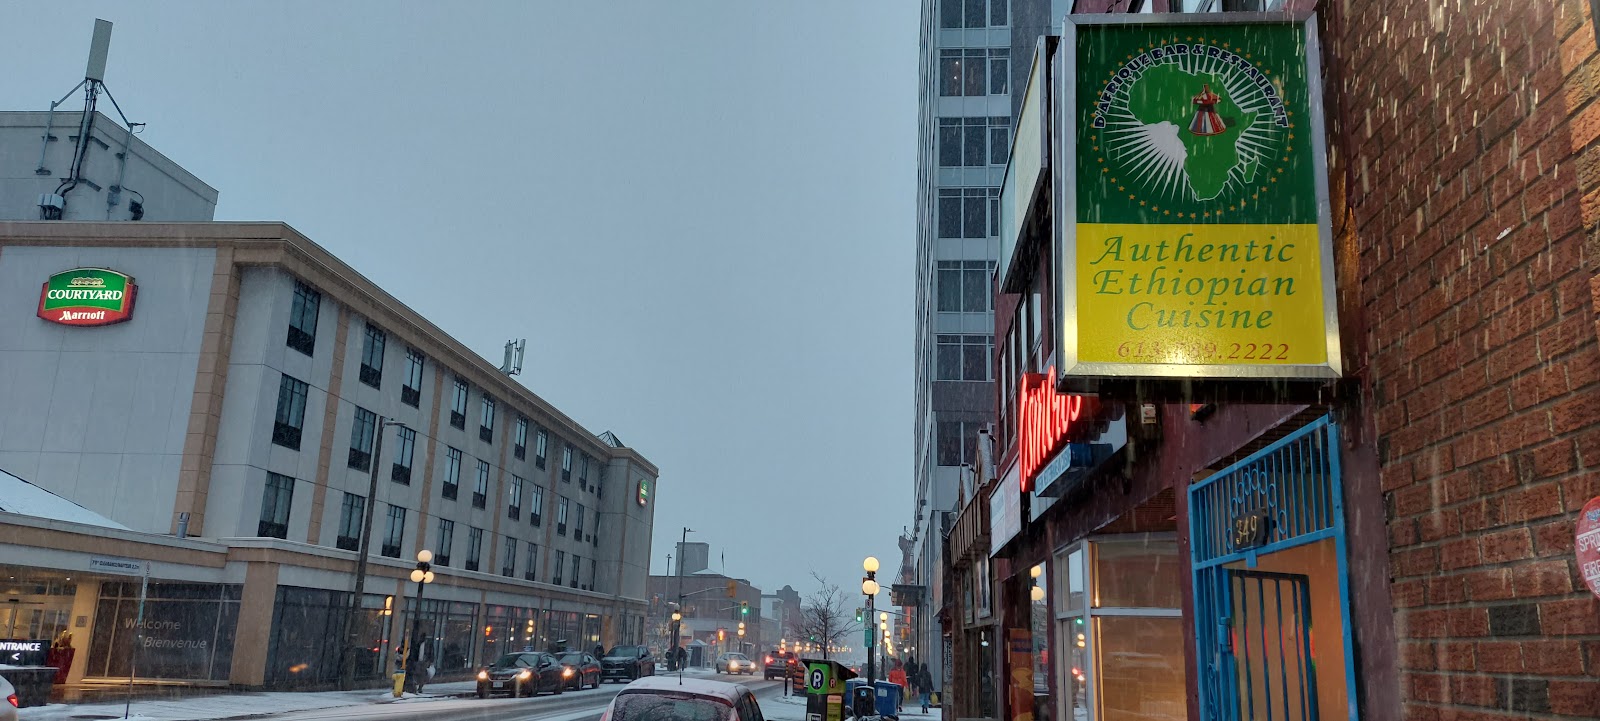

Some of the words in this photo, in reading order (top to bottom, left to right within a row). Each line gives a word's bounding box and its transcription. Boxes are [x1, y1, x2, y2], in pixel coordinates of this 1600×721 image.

[1093, 53, 1151, 129] D'AFRIQUE
[1151, 44, 1188, 61] BAR
[1192, 44, 1204, 56] &
[1207, 45, 1289, 128] RESTAURANT
[1089, 233, 1296, 265] Authentic
[47, 289, 123, 300] COURTYARD
[1092, 265, 1296, 305] Ethiopian
[58, 310, 105, 321] Marriott
[1126, 300, 1273, 331] Cuisine
[1235, 515, 1257, 545] 349
[125, 617, 181, 630] Welcome
[0, 642, 41, 652] NTRANCE
[143, 636, 207, 649] Bienvenue
